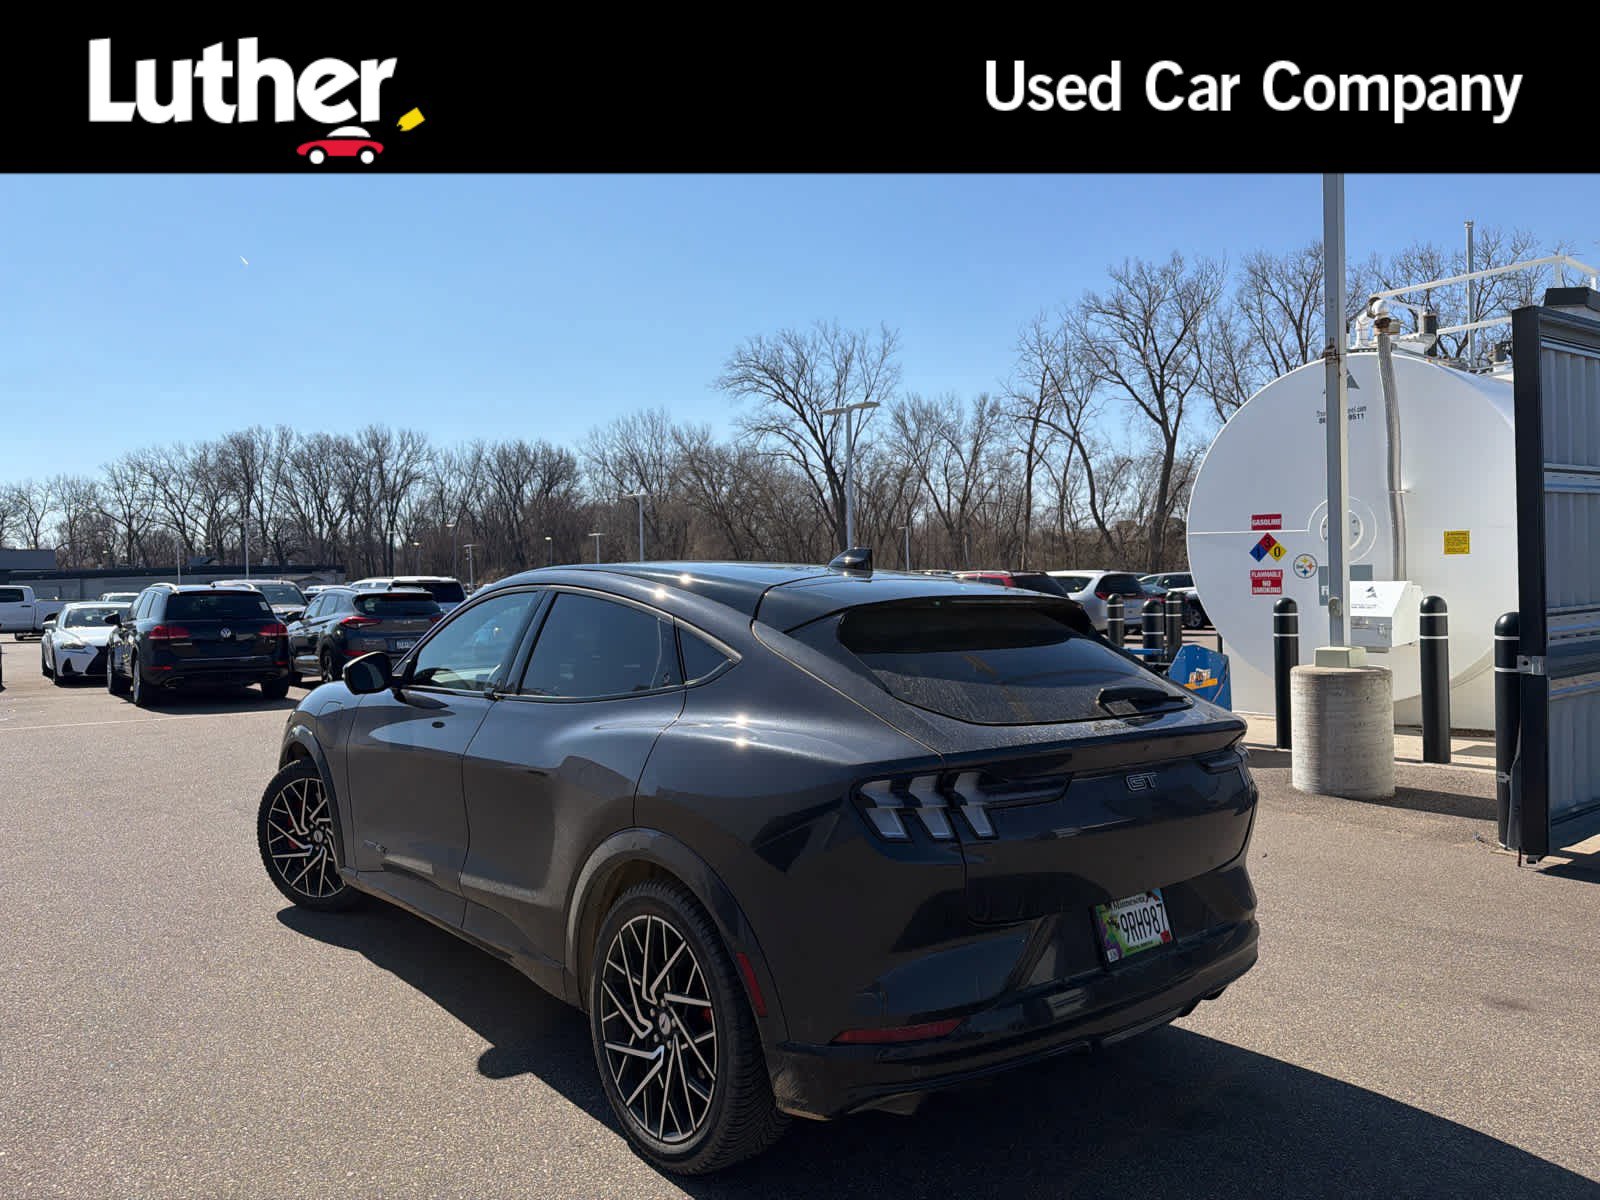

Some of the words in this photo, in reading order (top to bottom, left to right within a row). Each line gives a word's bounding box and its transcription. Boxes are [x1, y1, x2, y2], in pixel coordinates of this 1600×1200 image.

[1273, 546, 1281, 558] 0
[1126, 772, 1157, 791] GT
[1120, 903, 1167, 944] 9RH987
